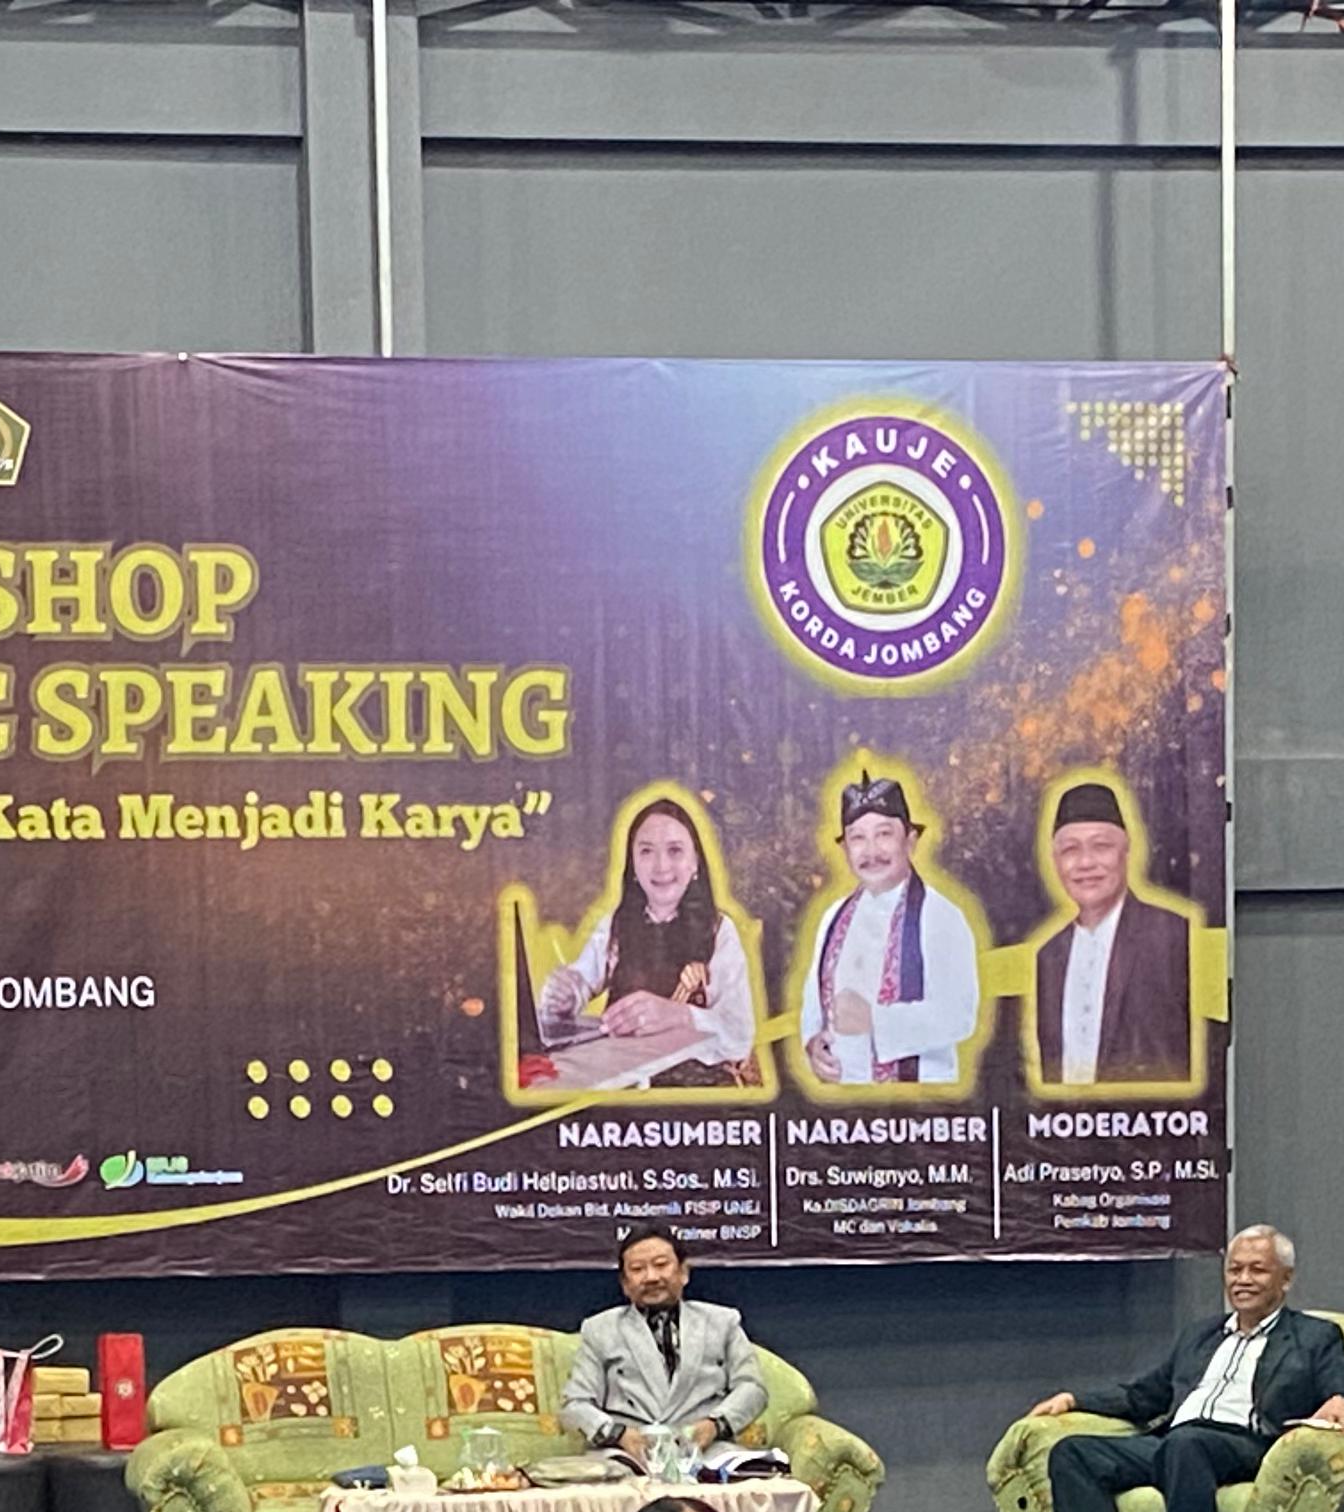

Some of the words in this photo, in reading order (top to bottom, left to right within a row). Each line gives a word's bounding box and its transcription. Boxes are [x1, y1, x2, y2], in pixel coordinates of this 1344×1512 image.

[810, 427, 957, 479] KAUJE
[834, 494, 933, 531] UNIVERSITAS
[850, 584, 919, 605] JEMBER
[779, 580, 856, 661] KORDA
[862, 587, 987, 666] JOMBANG
[34, 667, 570, 757] SPEAKING
[117, 790, 347, 851] Menjadi
[359, 790, 553, 851] Karya”
[558, 1120, 762, 1148] NARASUMBER
[786, 1117, 987, 1146] NARASUMBER
[1027, 1110, 1209, 1138] MODERATOR
[386, 1173, 417, 1195] Dr.
[419, 1170, 469, 1194] Selfi
[472, 1171, 518, 1193] Budi
[785, 1165, 824, 1187] Drs.
[827, 1164, 924, 1189] Suwignyo,
[928, 1163, 974, 1185] M.M.
[1003, 1162, 1035, 1183] Adi
[1039, 1161, 1126, 1185] Prasetyo,
[1174, 1158, 1220, 1180] M.Si.
[719, 1224, 762, 1241] BNSP
